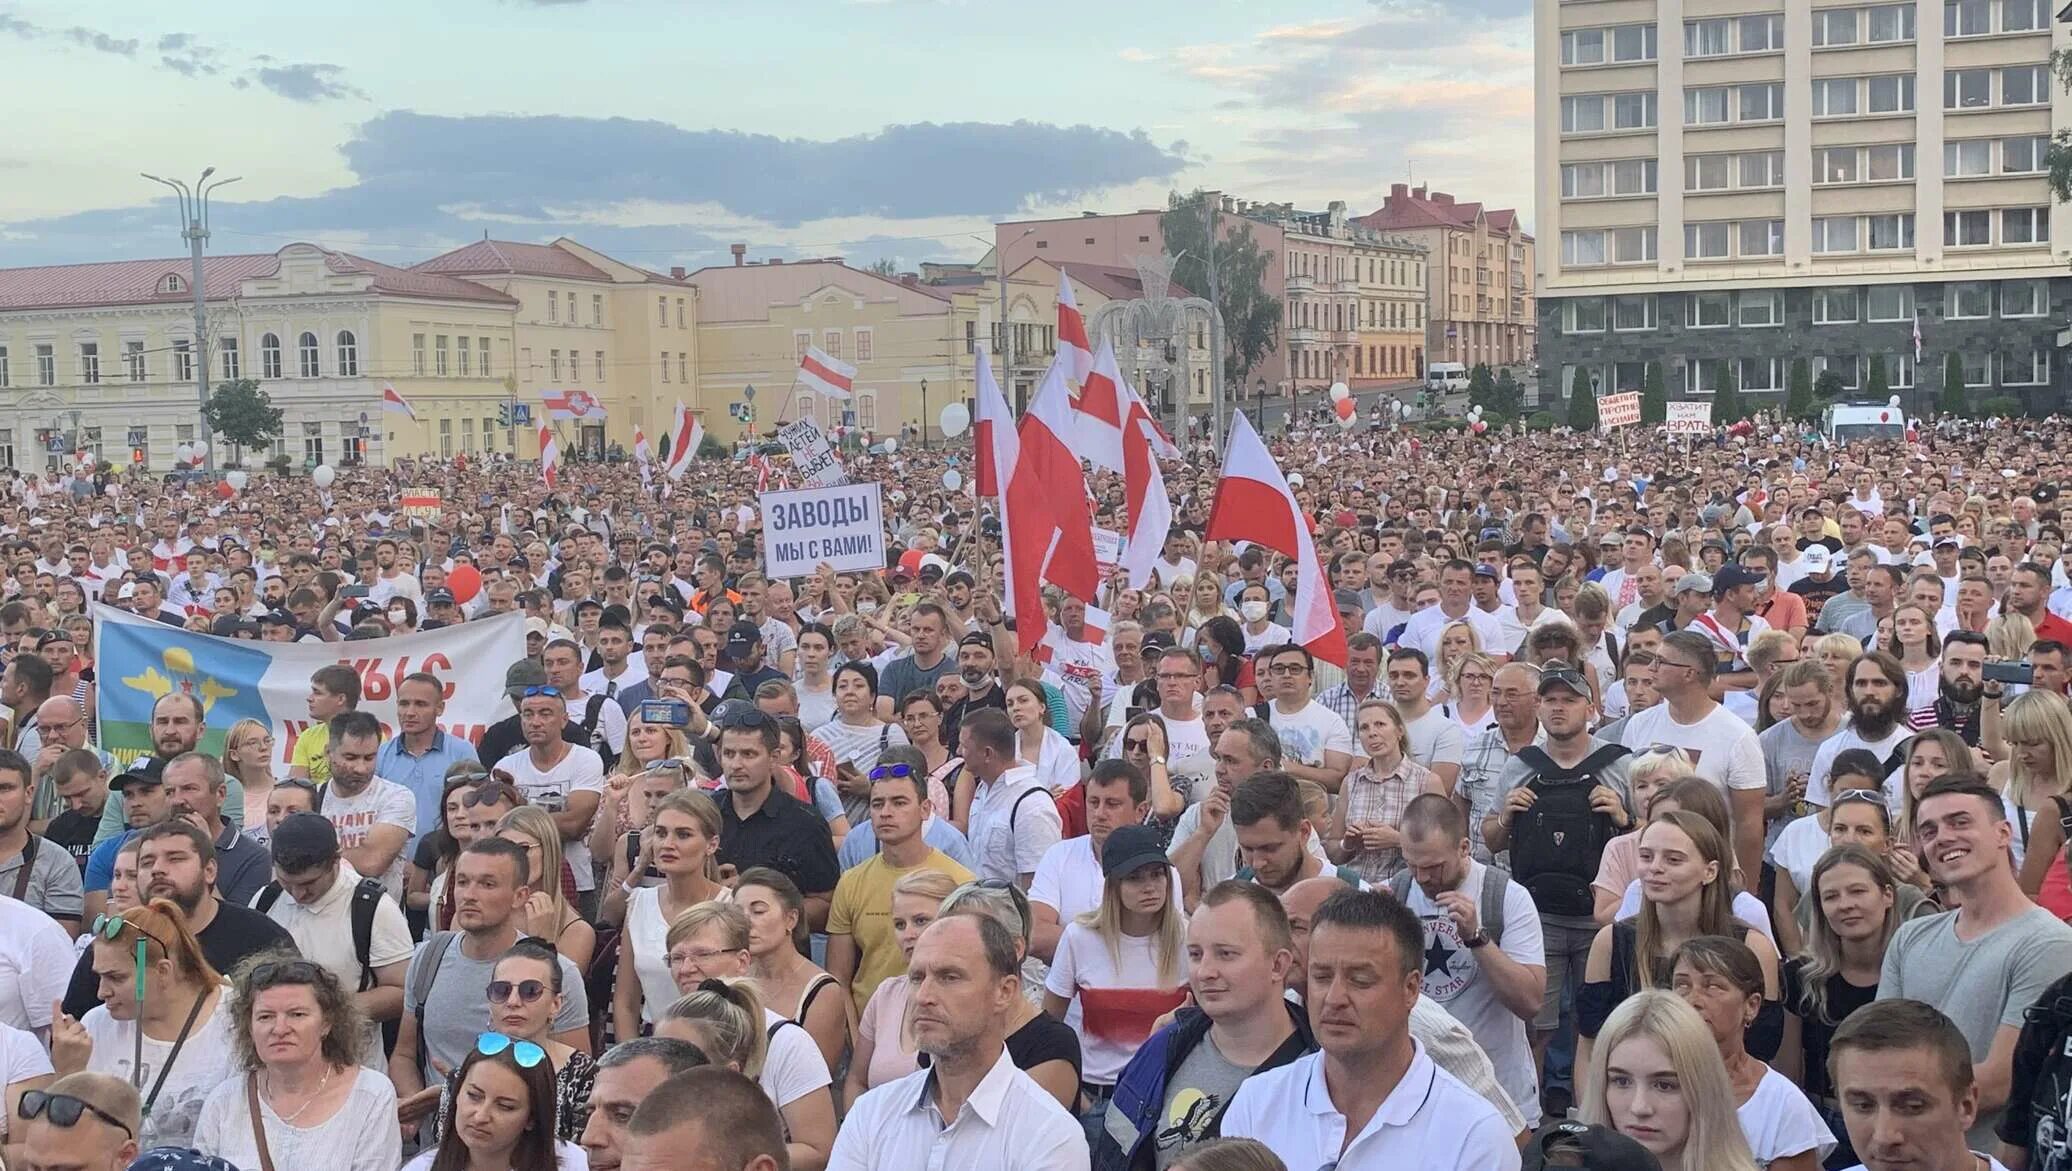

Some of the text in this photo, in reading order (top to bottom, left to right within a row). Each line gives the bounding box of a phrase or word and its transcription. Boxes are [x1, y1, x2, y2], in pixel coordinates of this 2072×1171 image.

[1669, 403, 1709, 411] ХВАТИТ
[780, 417, 812, 439] ЧУЖИХ
[1667, 420, 1709, 431] ВРАТЬ
[799, 449, 834, 479] БЫВАЕТ
[772, 495, 869, 530] ЗАВОДЫ
[775, 534, 872, 562] МЫ С ВАМИ!
[1423, 921, 1463, 949] NVERSE
[1435, 976, 1465, 996] STAR
